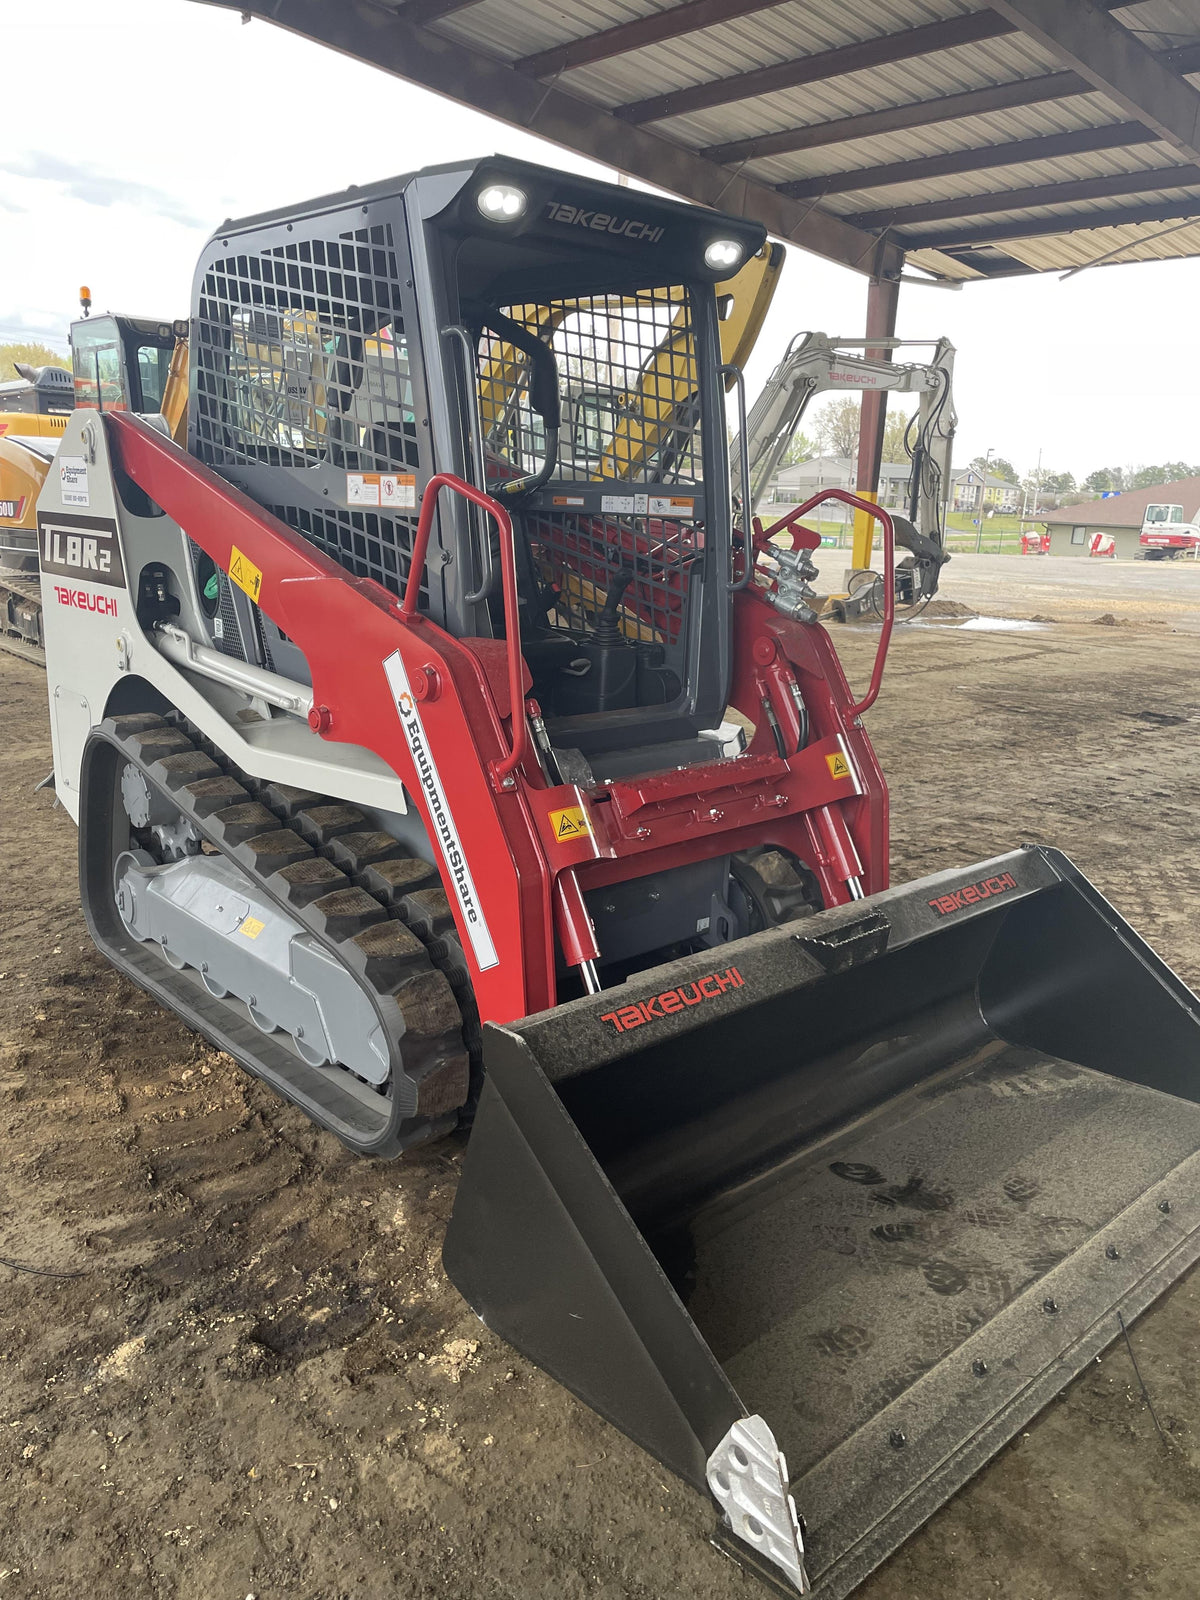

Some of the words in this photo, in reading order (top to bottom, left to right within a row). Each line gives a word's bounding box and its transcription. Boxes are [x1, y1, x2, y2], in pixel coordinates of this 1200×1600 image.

[546, 201, 665, 242] TAKEUCHI
[827, 371, 877, 385] TAKEUCHI
[54, 586, 118, 617] TAKEUCHI
[406, 718, 478, 924] EquipmentShare
[928, 872, 1017, 915] TAKEUCHI
[600, 966, 746, 1033] TAKEUCHI
